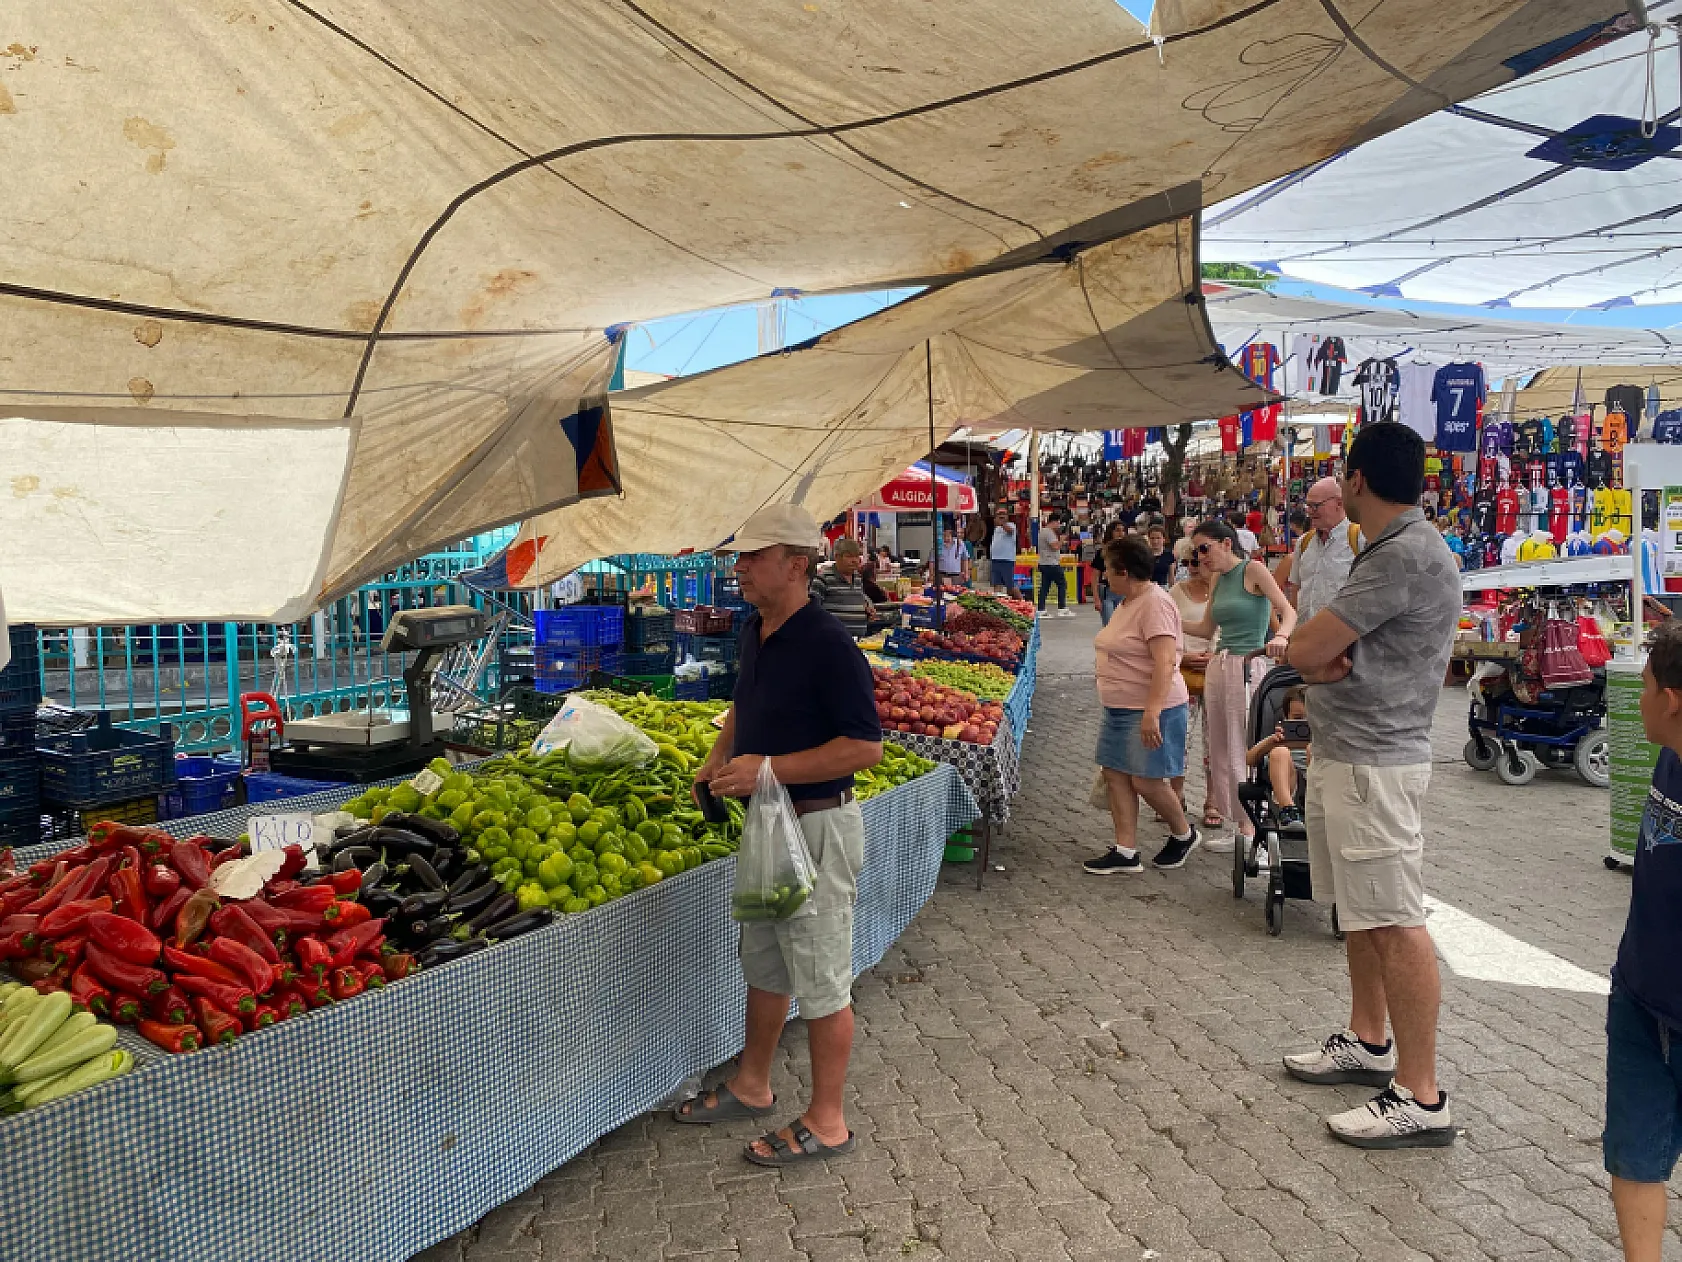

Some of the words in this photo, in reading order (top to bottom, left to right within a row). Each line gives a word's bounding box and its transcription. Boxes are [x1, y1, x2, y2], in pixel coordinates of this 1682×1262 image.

[1370, 387, 1383, 407] 10
[1449, 387, 1464, 417] 7
[892, 490, 934, 503] ALGIDA
[1479, 507, 1488, 527] 7
